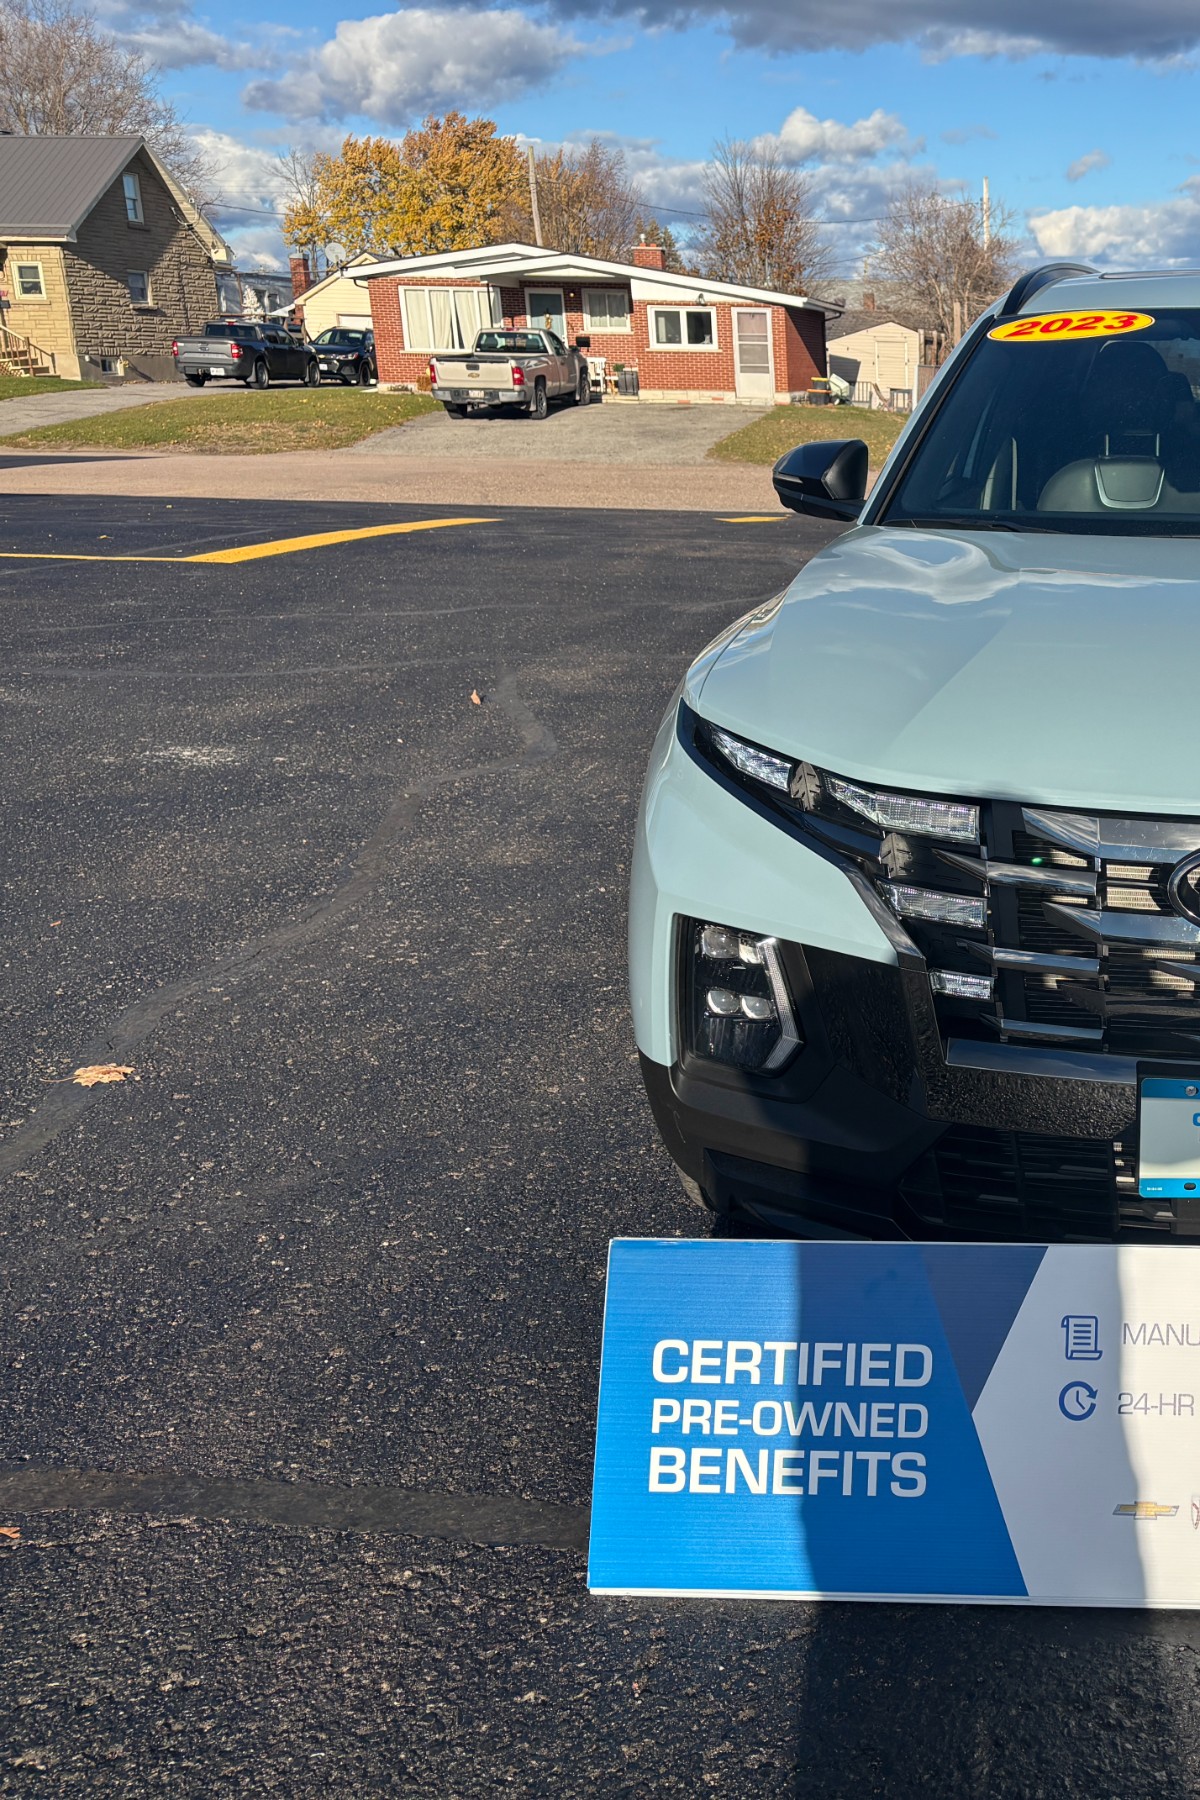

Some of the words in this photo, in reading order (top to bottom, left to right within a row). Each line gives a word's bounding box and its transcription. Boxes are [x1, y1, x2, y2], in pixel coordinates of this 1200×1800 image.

[1004, 315, 1138, 338] 2023
[652, 1339, 933, 1388] CERTIFIED
[651, 1398, 929, 1439] PRE-OWNED
[1117, 1392, 1195, 1416] 24-HR
[648, 1446, 927, 1498] BENEFITS
